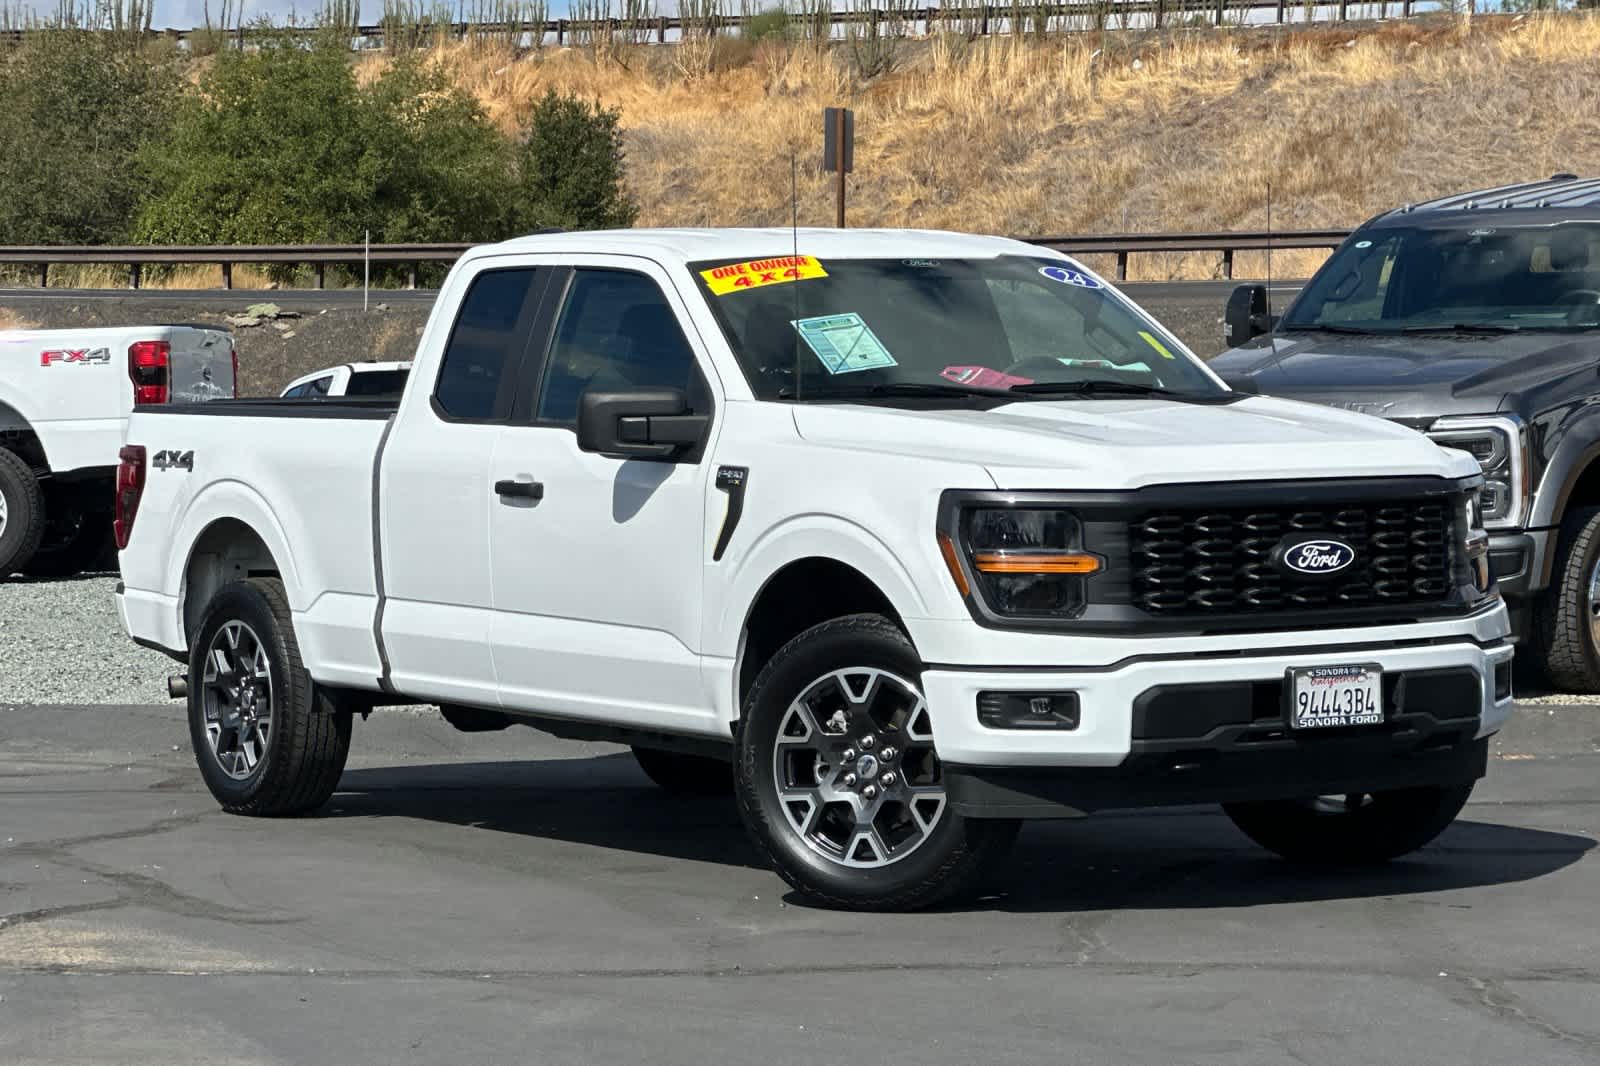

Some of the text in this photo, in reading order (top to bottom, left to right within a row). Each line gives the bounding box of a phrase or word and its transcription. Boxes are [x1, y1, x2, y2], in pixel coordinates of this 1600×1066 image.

[711, 256, 809, 280] ONE OWNER
[734, 276, 754, 288] 4
[1056, 269, 1087, 286] 24
[40, 347, 110, 367] FX4
[1298, 545, 1341, 568] Ford
[1315, 667, 1349, 677] SONORA
[1299, 687, 1375, 718] 94443B4
[1299, 714, 1379, 728] SONORA FORD
